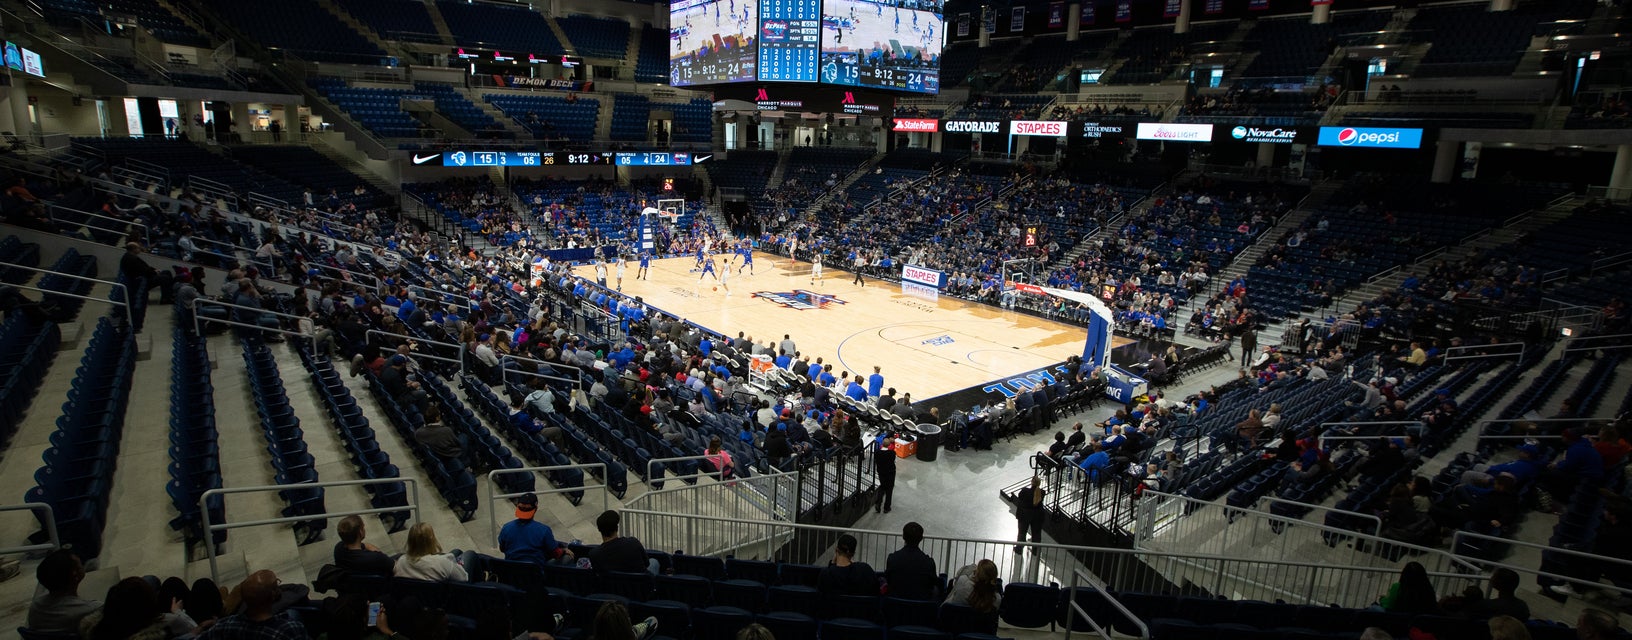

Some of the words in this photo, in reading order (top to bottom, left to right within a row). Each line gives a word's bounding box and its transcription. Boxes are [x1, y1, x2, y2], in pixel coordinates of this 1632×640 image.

[684, 68, 692, 78] 15
[702, 65, 716, 74] 9:12
[728, 63, 739, 74] 24
[845, 66, 858, 78] 15
[875, 69, 892, 79] 9:12
[909, 73, 921, 84] 24
[512, 77, 546, 86] DEMON
[945, 121, 1000, 133] GATORADE
[1016, 122, 1060, 134] STAPLES
[1153, 128, 1176, 138] Coors
[1246, 128, 1296, 138] NovaCare
[1358, 131, 1399, 144] pepsi
[480, 154, 492, 164] 15
[523, 156, 534, 165] 05
[568, 154, 589, 163] 9:12
[655, 154, 665, 163] 24
[905, 268, 936, 283] STAPLES
